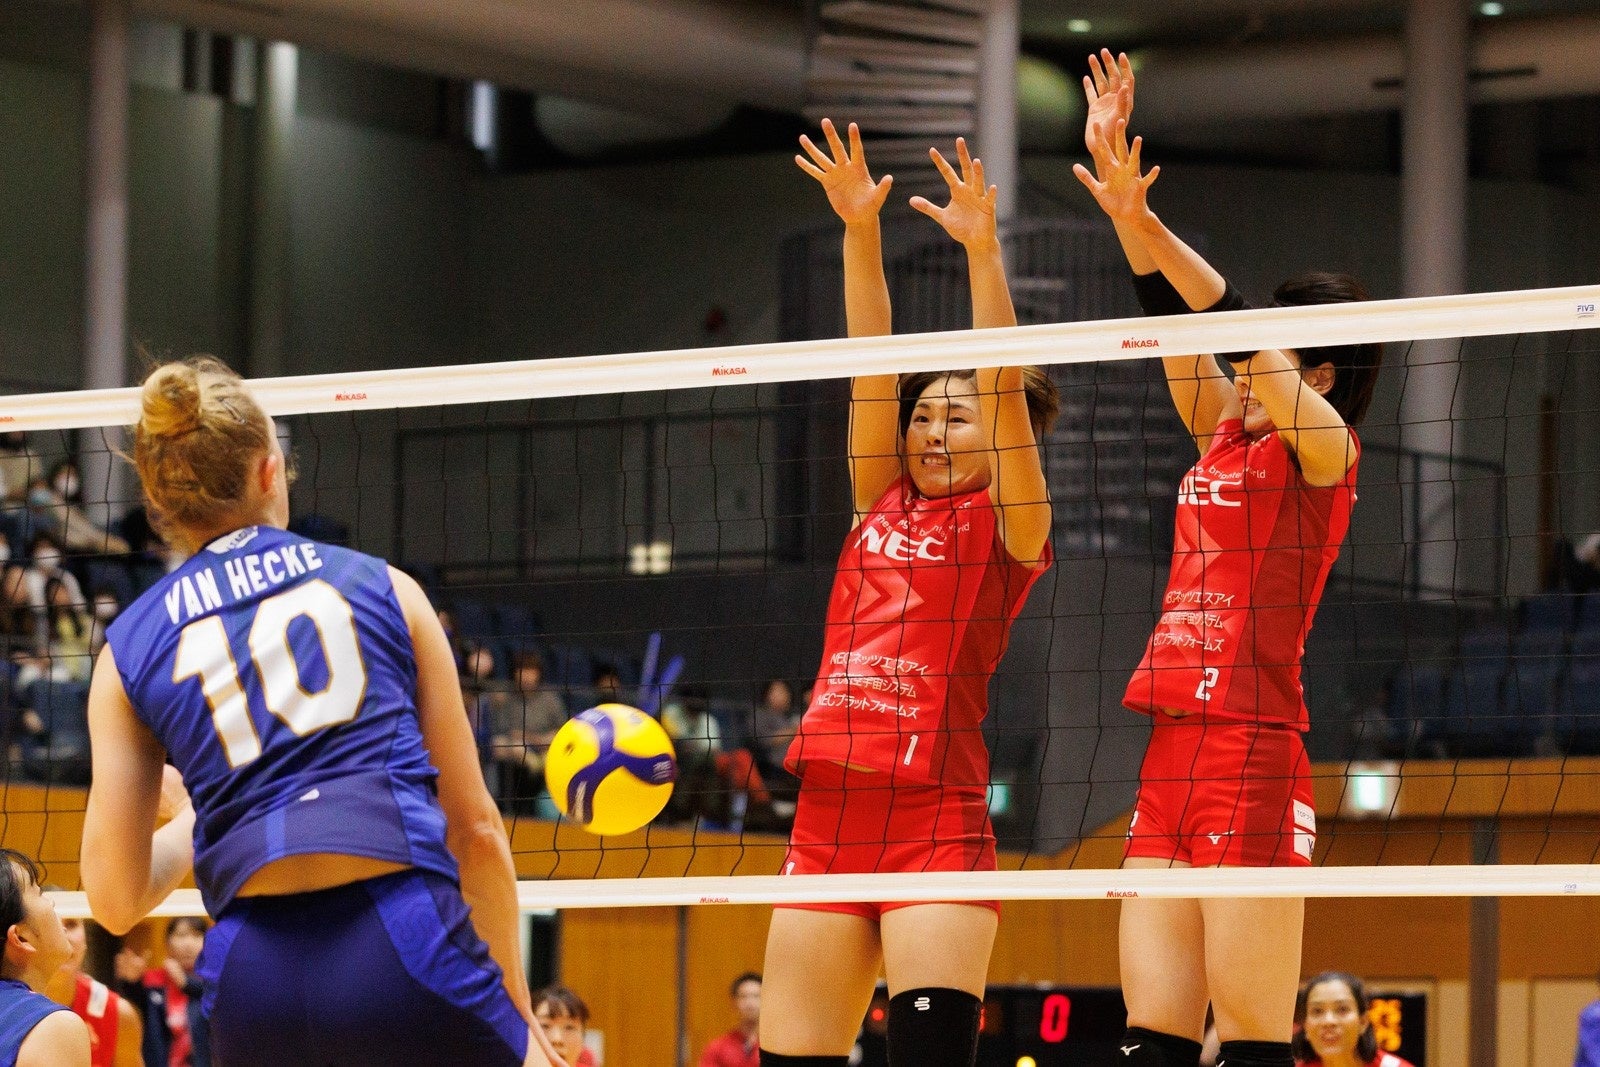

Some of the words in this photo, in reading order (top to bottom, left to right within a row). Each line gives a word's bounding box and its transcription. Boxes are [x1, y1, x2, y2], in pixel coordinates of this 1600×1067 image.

[1577, 304, 1595, 312] FIVB
[853, 525, 946, 561] NEC
[164, 567, 223, 625] VAN
[224, 542, 323, 600] HECKE
[172, 577, 369, 770] 10
[1195, 667, 1219, 701] 2
[903, 734, 918, 766] 1
[1040, 994, 1071, 1043] 0
